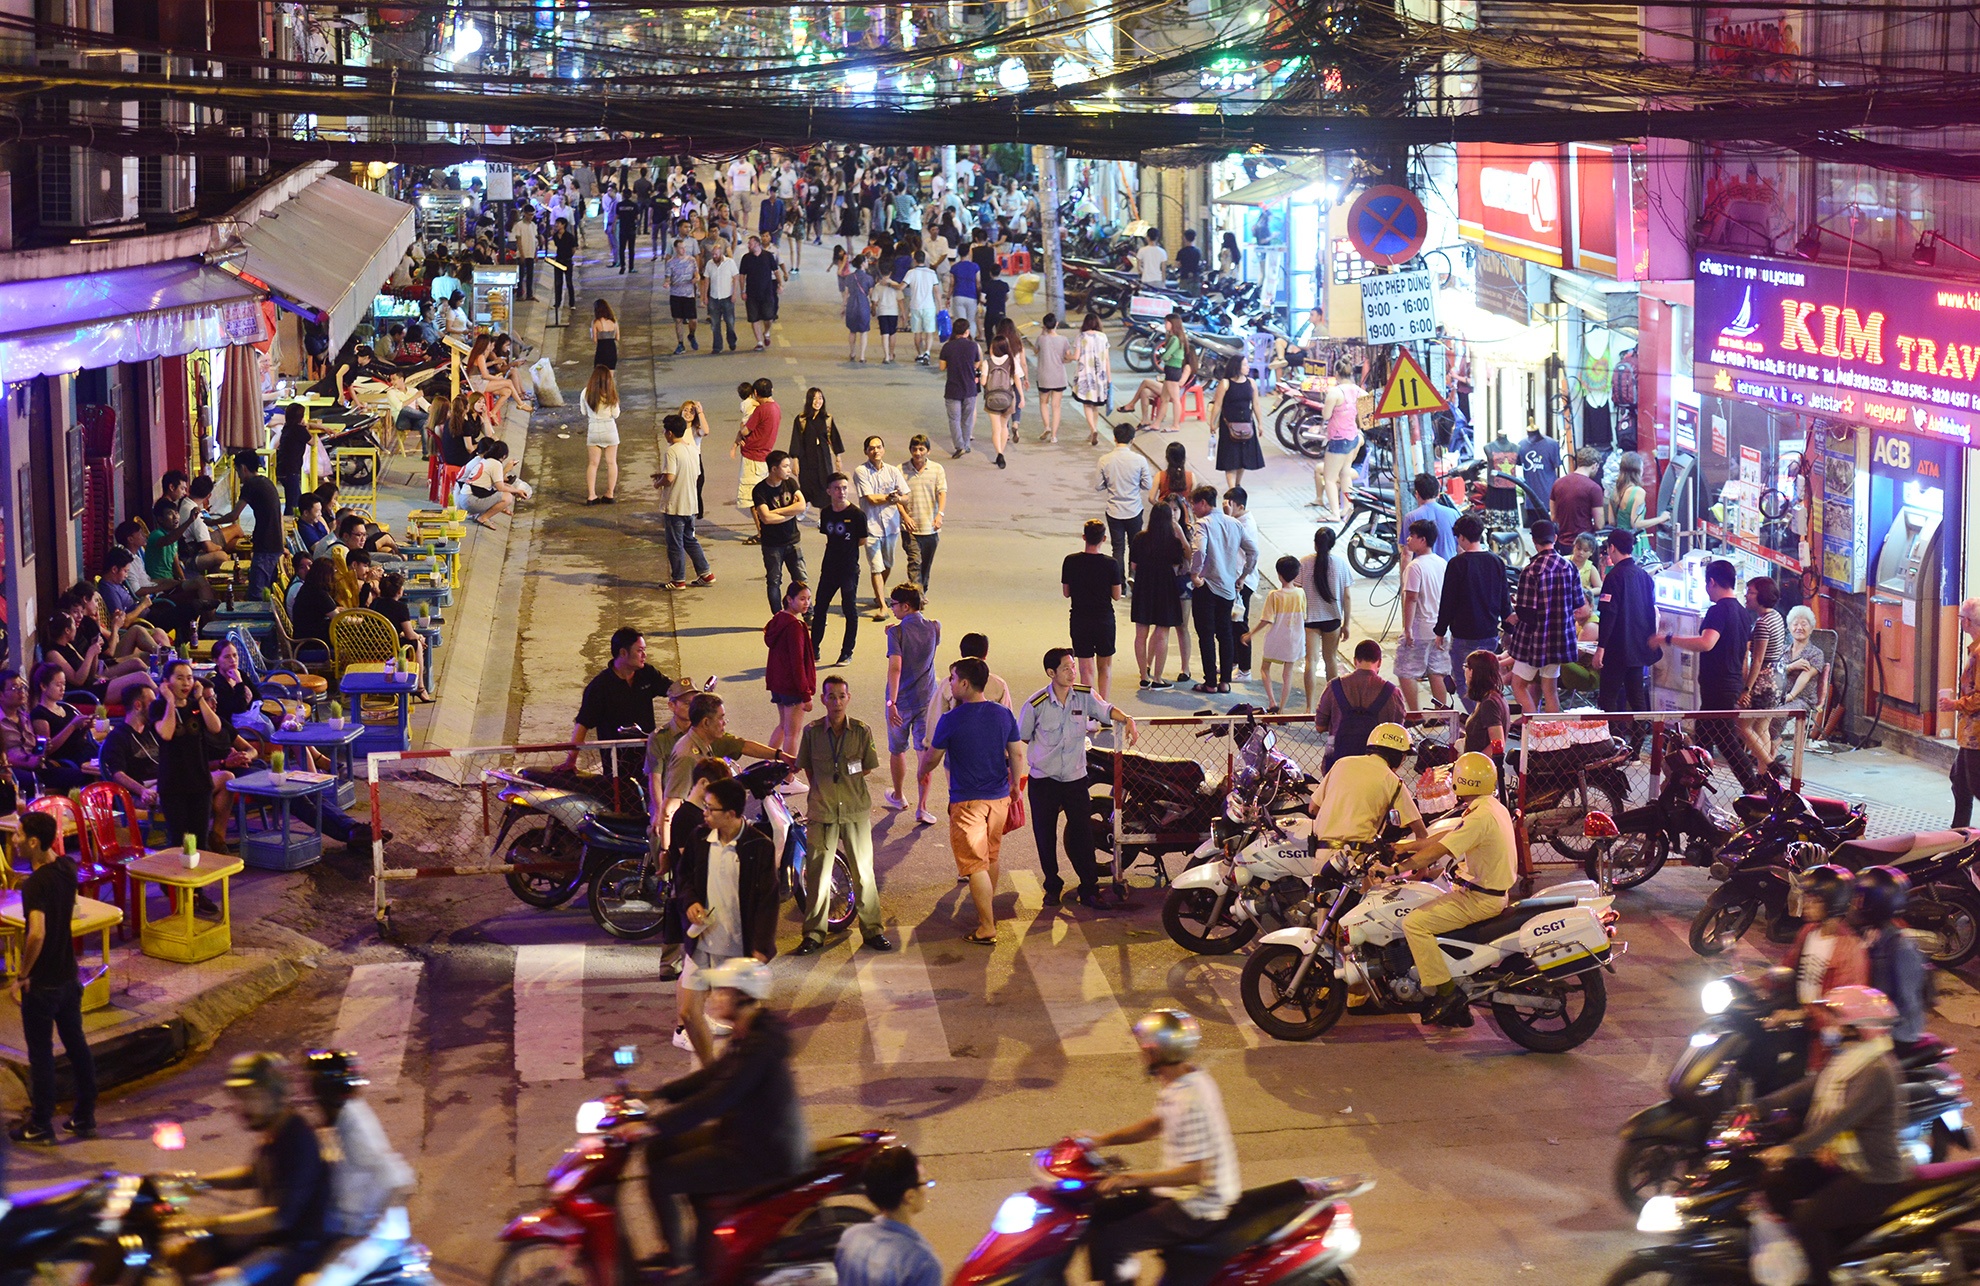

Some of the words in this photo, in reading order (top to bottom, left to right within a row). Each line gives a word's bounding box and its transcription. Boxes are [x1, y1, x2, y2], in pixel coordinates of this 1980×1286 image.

[489, 163, 510, 173] NAM
[1362, 280, 1384, 300] ĐƯỢC
[1367, 302, 1391, 318] 9:00
[1402, 297, 1430, 314] 16:00
[1937, 291, 1980, 311] www.ki
[1368, 322, 1396, 339] 19:00
[1409, 318, 1433, 334] 6:00
[1780, 299, 1885, 365] KIM
[1896, 335, 1980, 381] TRAV
[1808, 393, 1843, 413] Jetstar
[1873, 435, 1911, 469] ACB
[1917, 459, 1941, 478] ATM
[845, 532, 851, 540] 2
[1382, 733, 1405, 744] CSGT
[1456, 776, 1482, 788] CSGT
[1278, 849, 1309, 859] CSGT
[1533, 918, 1567, 937] CSGT
